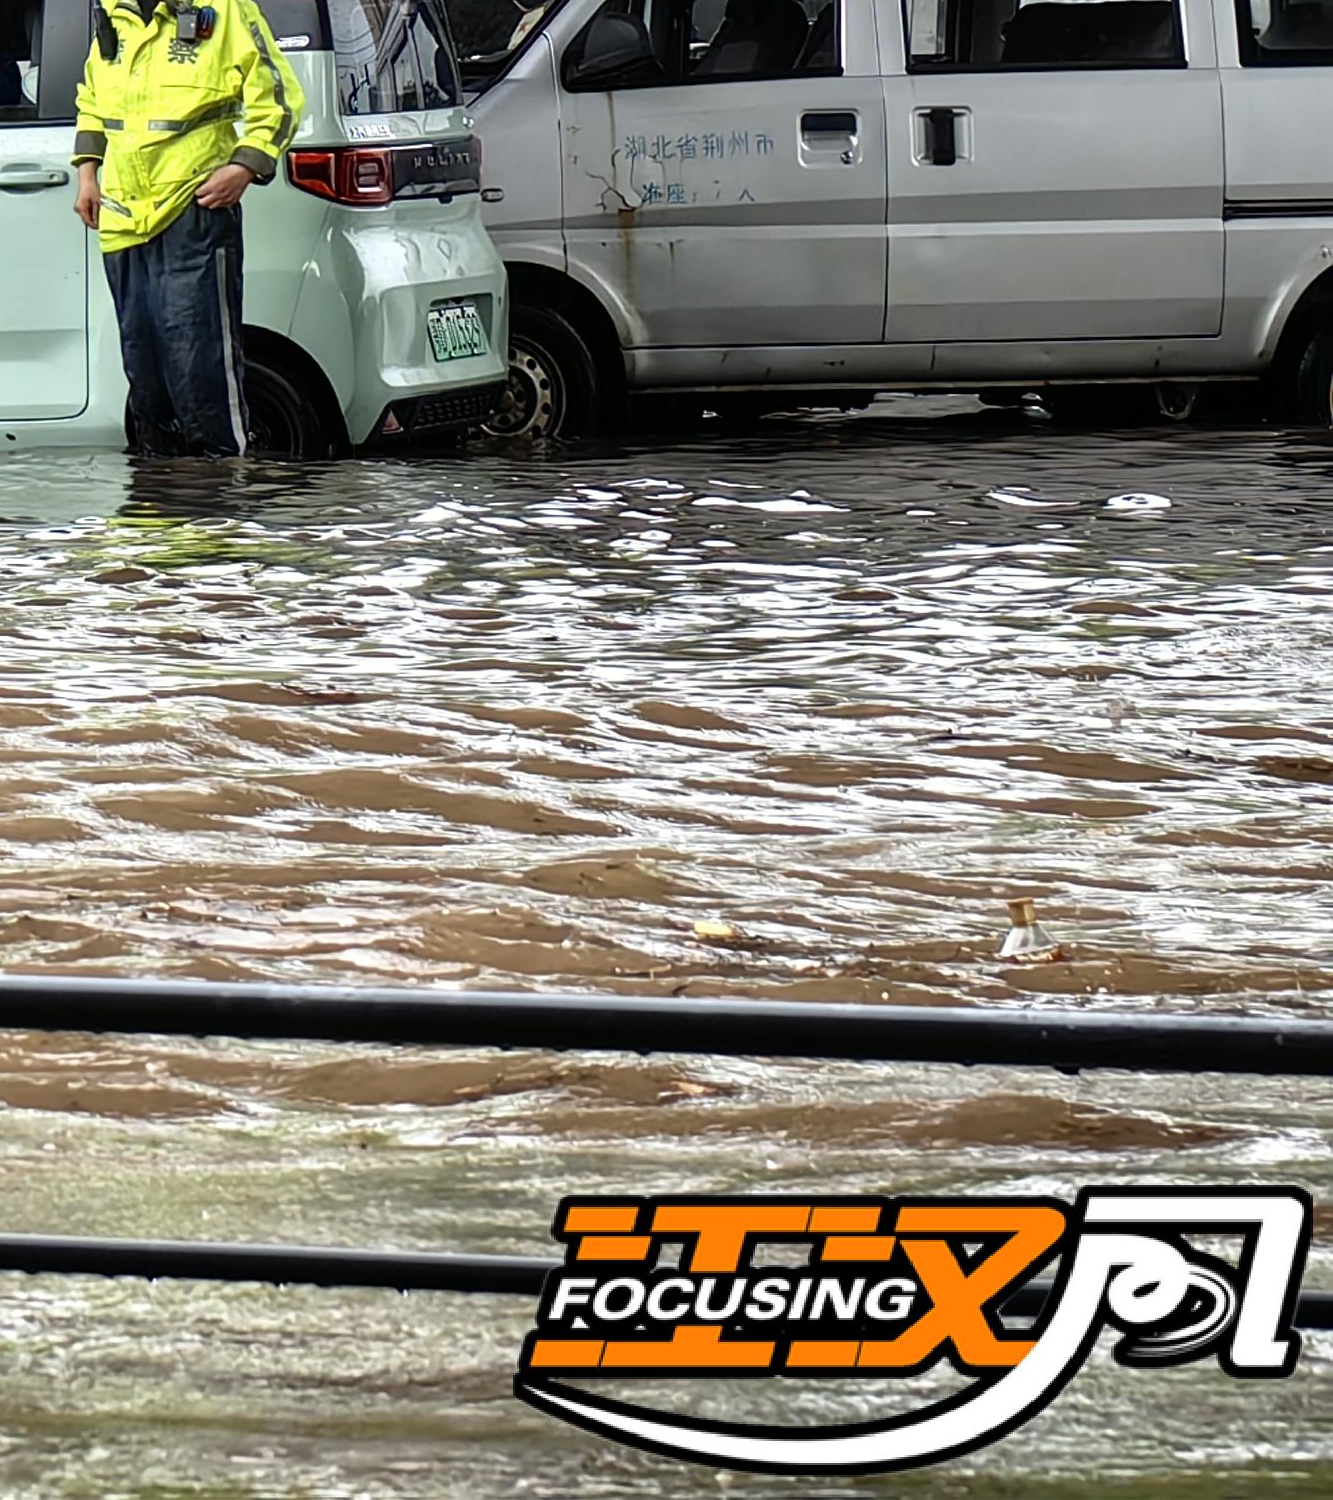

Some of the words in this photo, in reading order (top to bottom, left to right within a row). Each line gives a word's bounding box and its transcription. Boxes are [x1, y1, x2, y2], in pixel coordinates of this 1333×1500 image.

[624, 132, 774, 159] 湖北省荆州市
